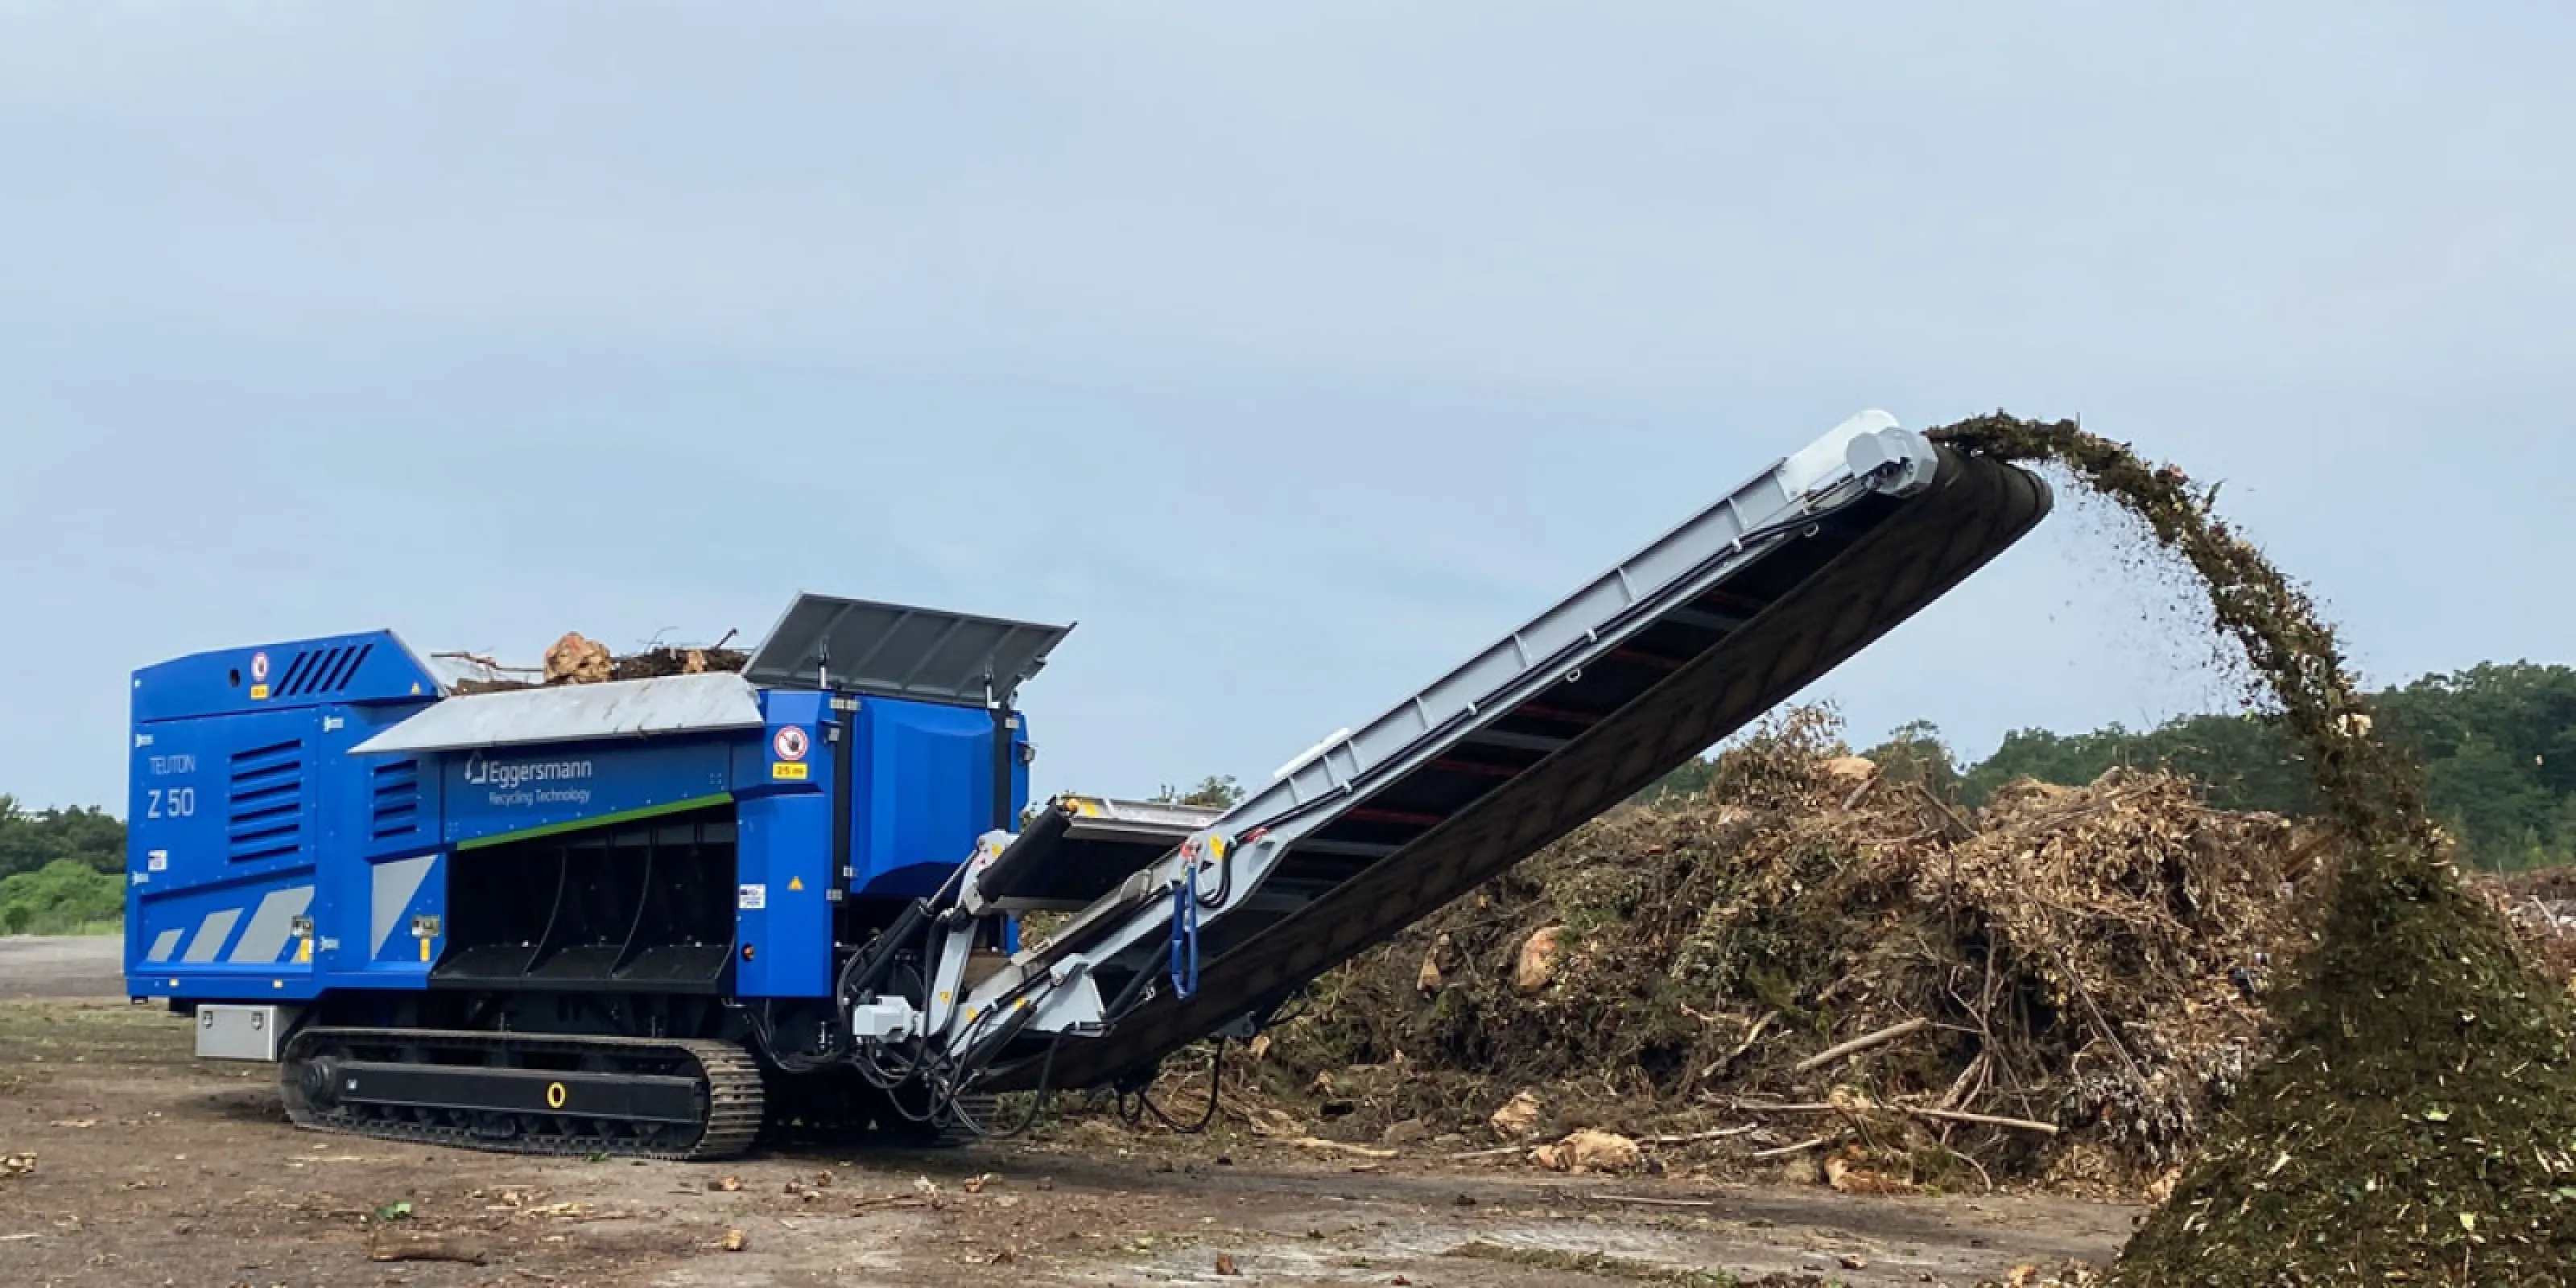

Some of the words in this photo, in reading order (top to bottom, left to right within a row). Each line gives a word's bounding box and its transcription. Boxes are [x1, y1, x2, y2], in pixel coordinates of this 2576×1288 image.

[149, 754, 196, 774] TEUTON
[489, 760, 592, 788] Eggersmann
[147, 789, 162, 819] Z
[167, 787, 195, 817] 50
[489, 790, 534, 807] Recycling
[536, 786, 592, 804] Technology
